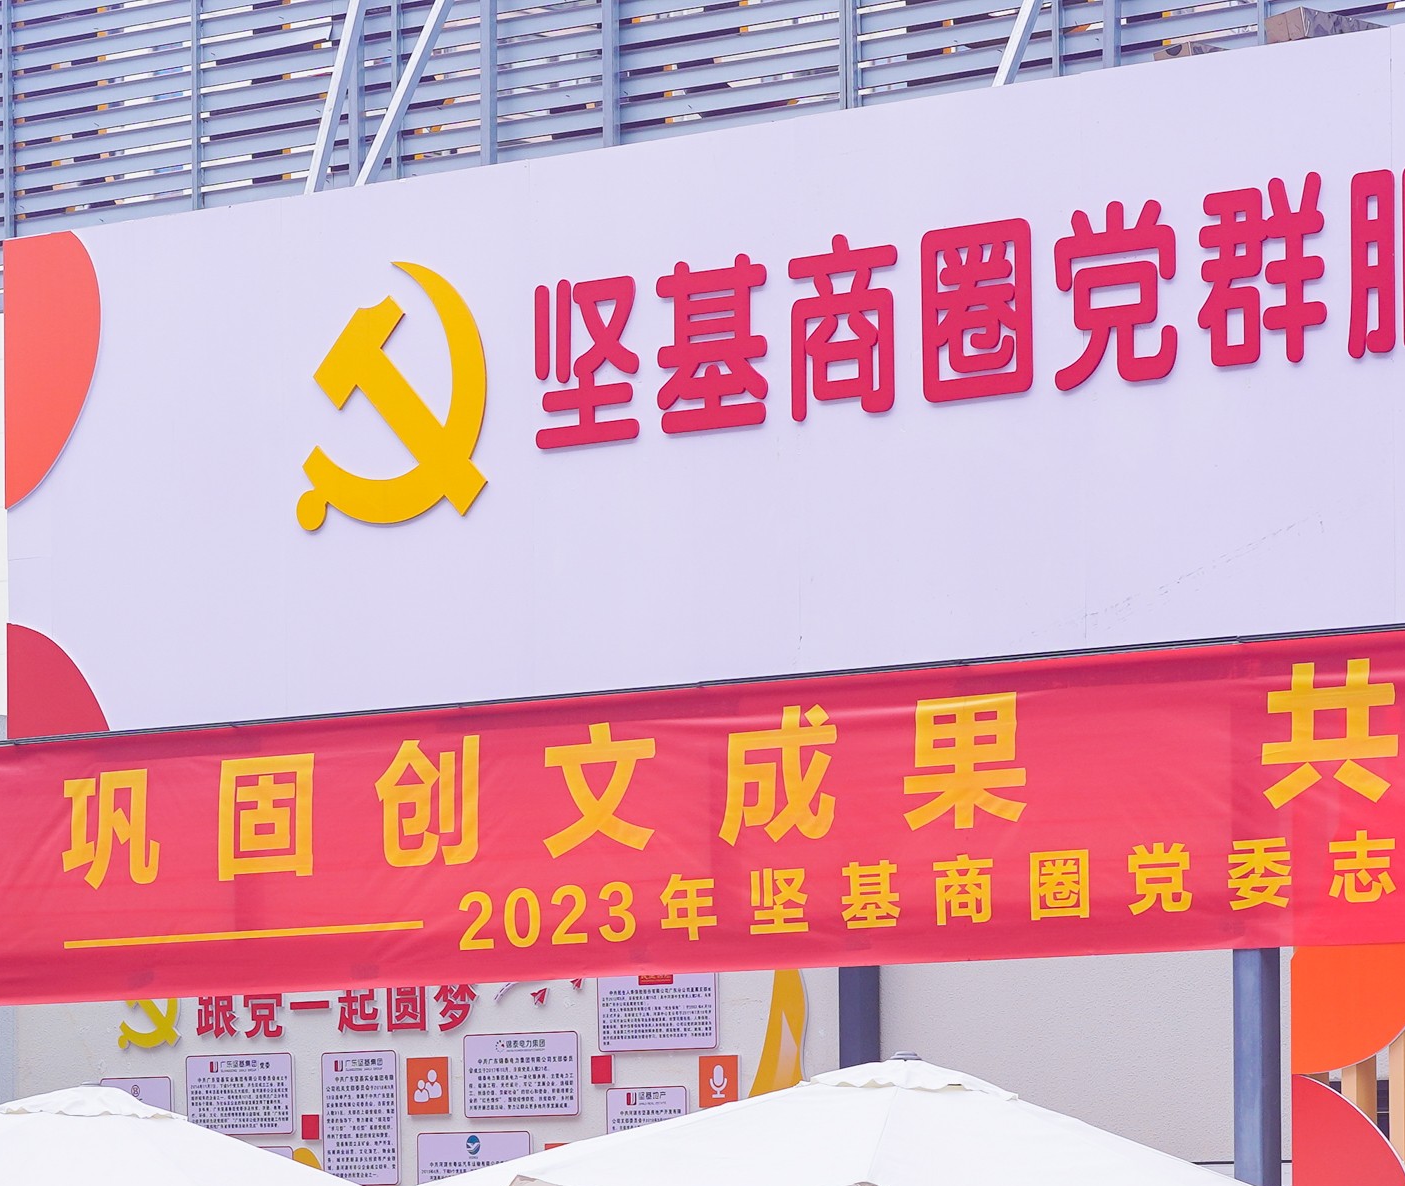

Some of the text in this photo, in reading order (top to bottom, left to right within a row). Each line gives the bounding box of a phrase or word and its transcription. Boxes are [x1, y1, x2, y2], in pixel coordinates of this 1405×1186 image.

[64, 691, 1026, 888] 巩固创文成果
